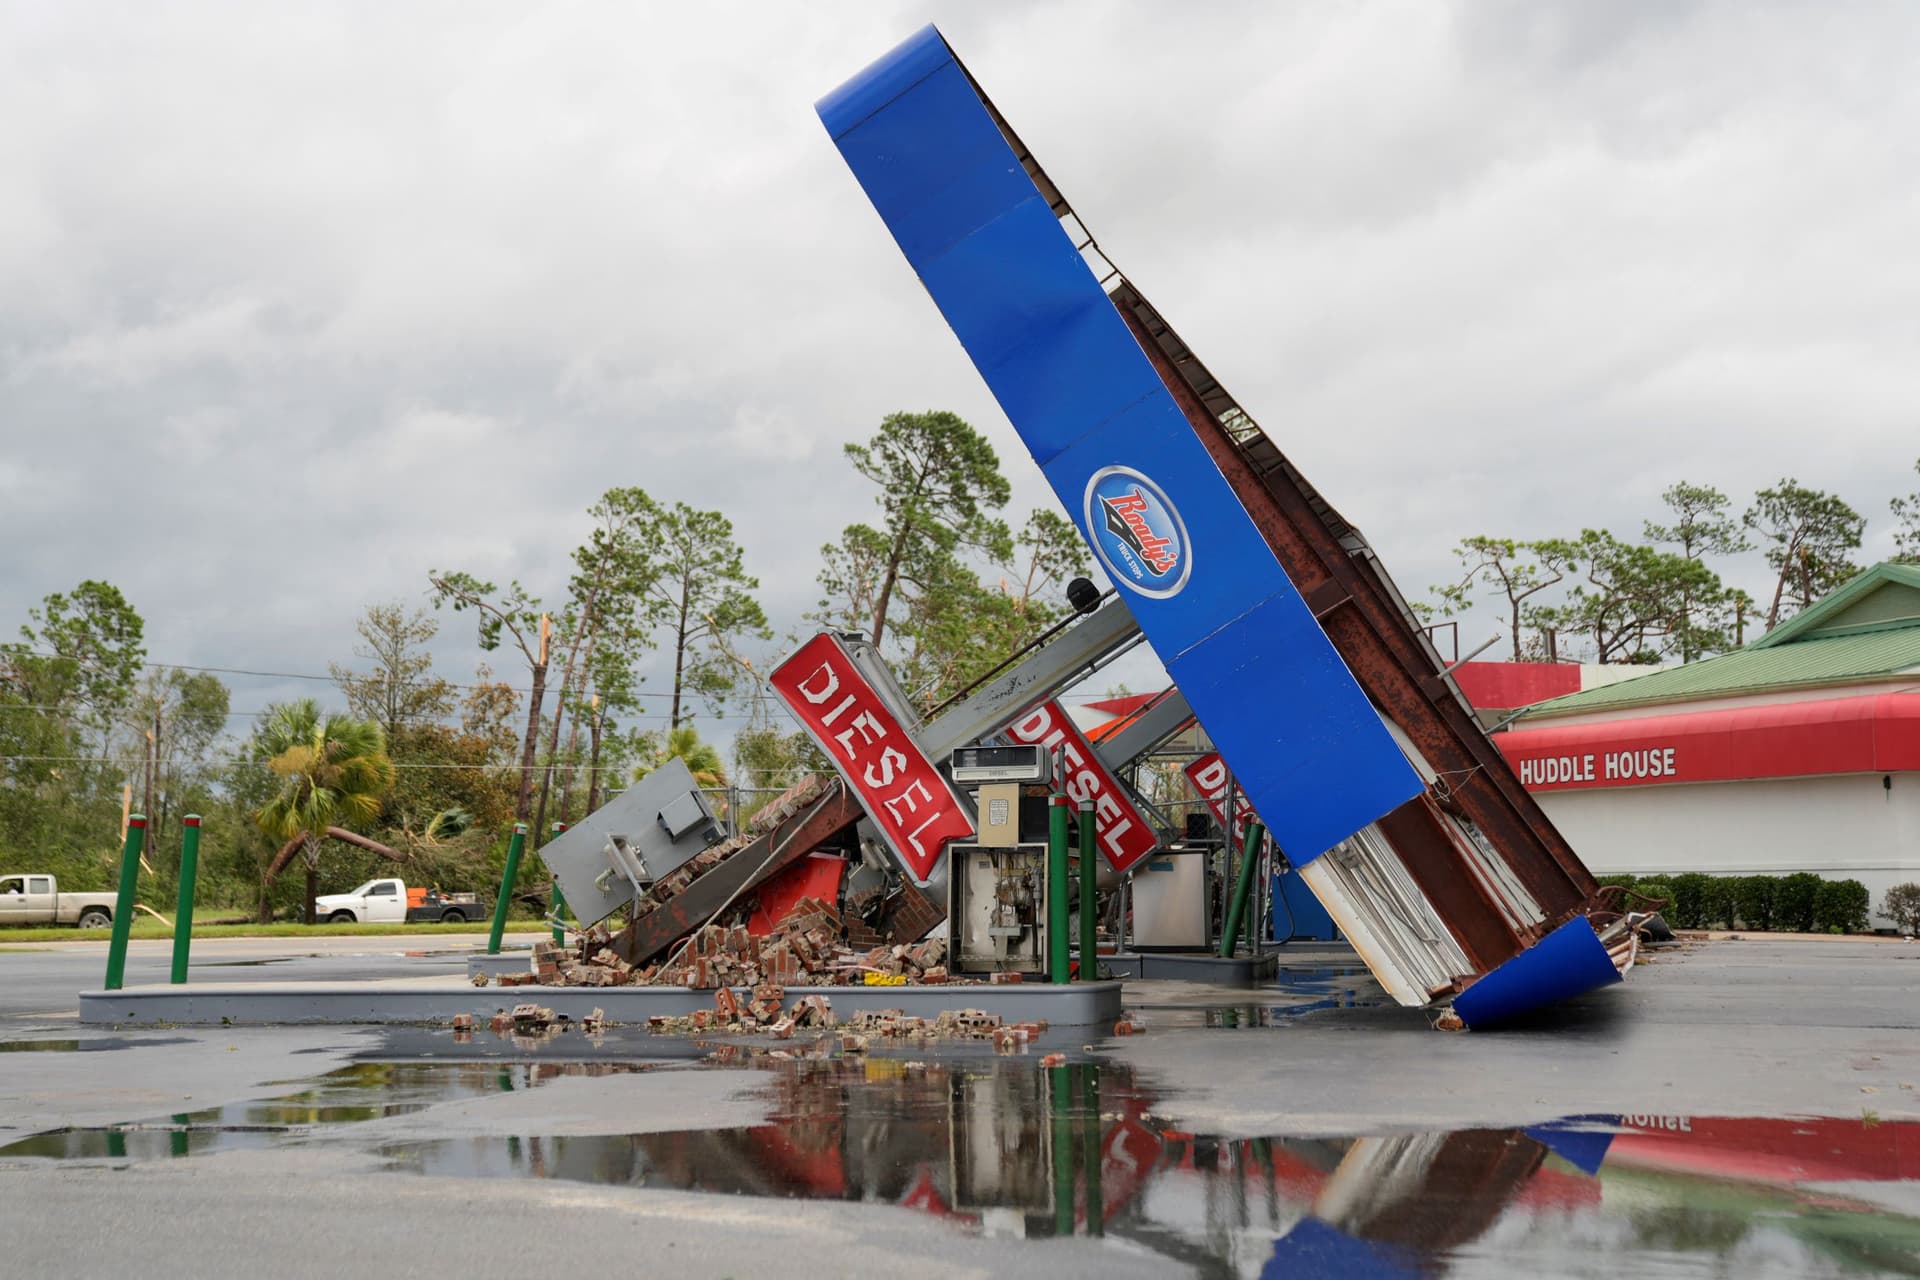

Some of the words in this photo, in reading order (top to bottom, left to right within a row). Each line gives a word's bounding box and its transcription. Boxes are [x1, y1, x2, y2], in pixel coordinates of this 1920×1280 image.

[1106, 487, 1178, 572] Roady's
[1117, 542, 1133, 562] TRUCK
[1128, 559, 1144, 579] STOPS
[797, 660, 941, 858] DIESEL
[1011, 706, 1133, 858] DIESEL
[1520, 754, 1596, 786] HUDDLE
[1605, 748, 1677, 780] HOUSE
